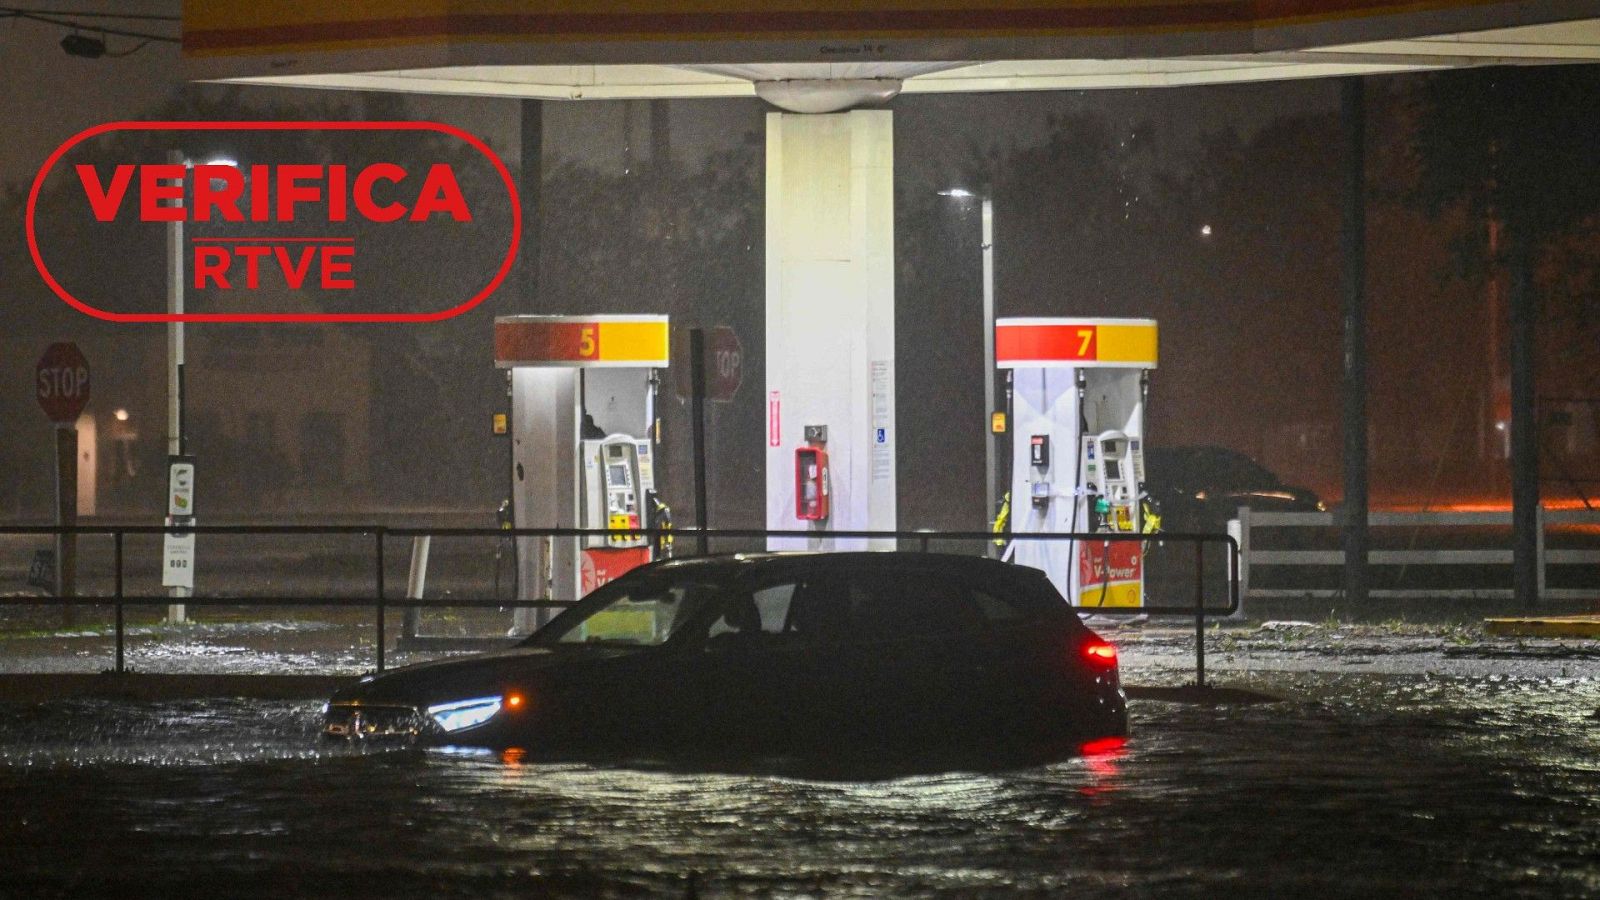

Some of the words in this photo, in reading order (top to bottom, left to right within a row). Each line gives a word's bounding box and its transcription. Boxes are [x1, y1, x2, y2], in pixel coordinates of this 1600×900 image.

[579, 328, 595, 357] 5
[1077, 330, 1093, 357] 7
[40, 367, 88, 398] STOP
